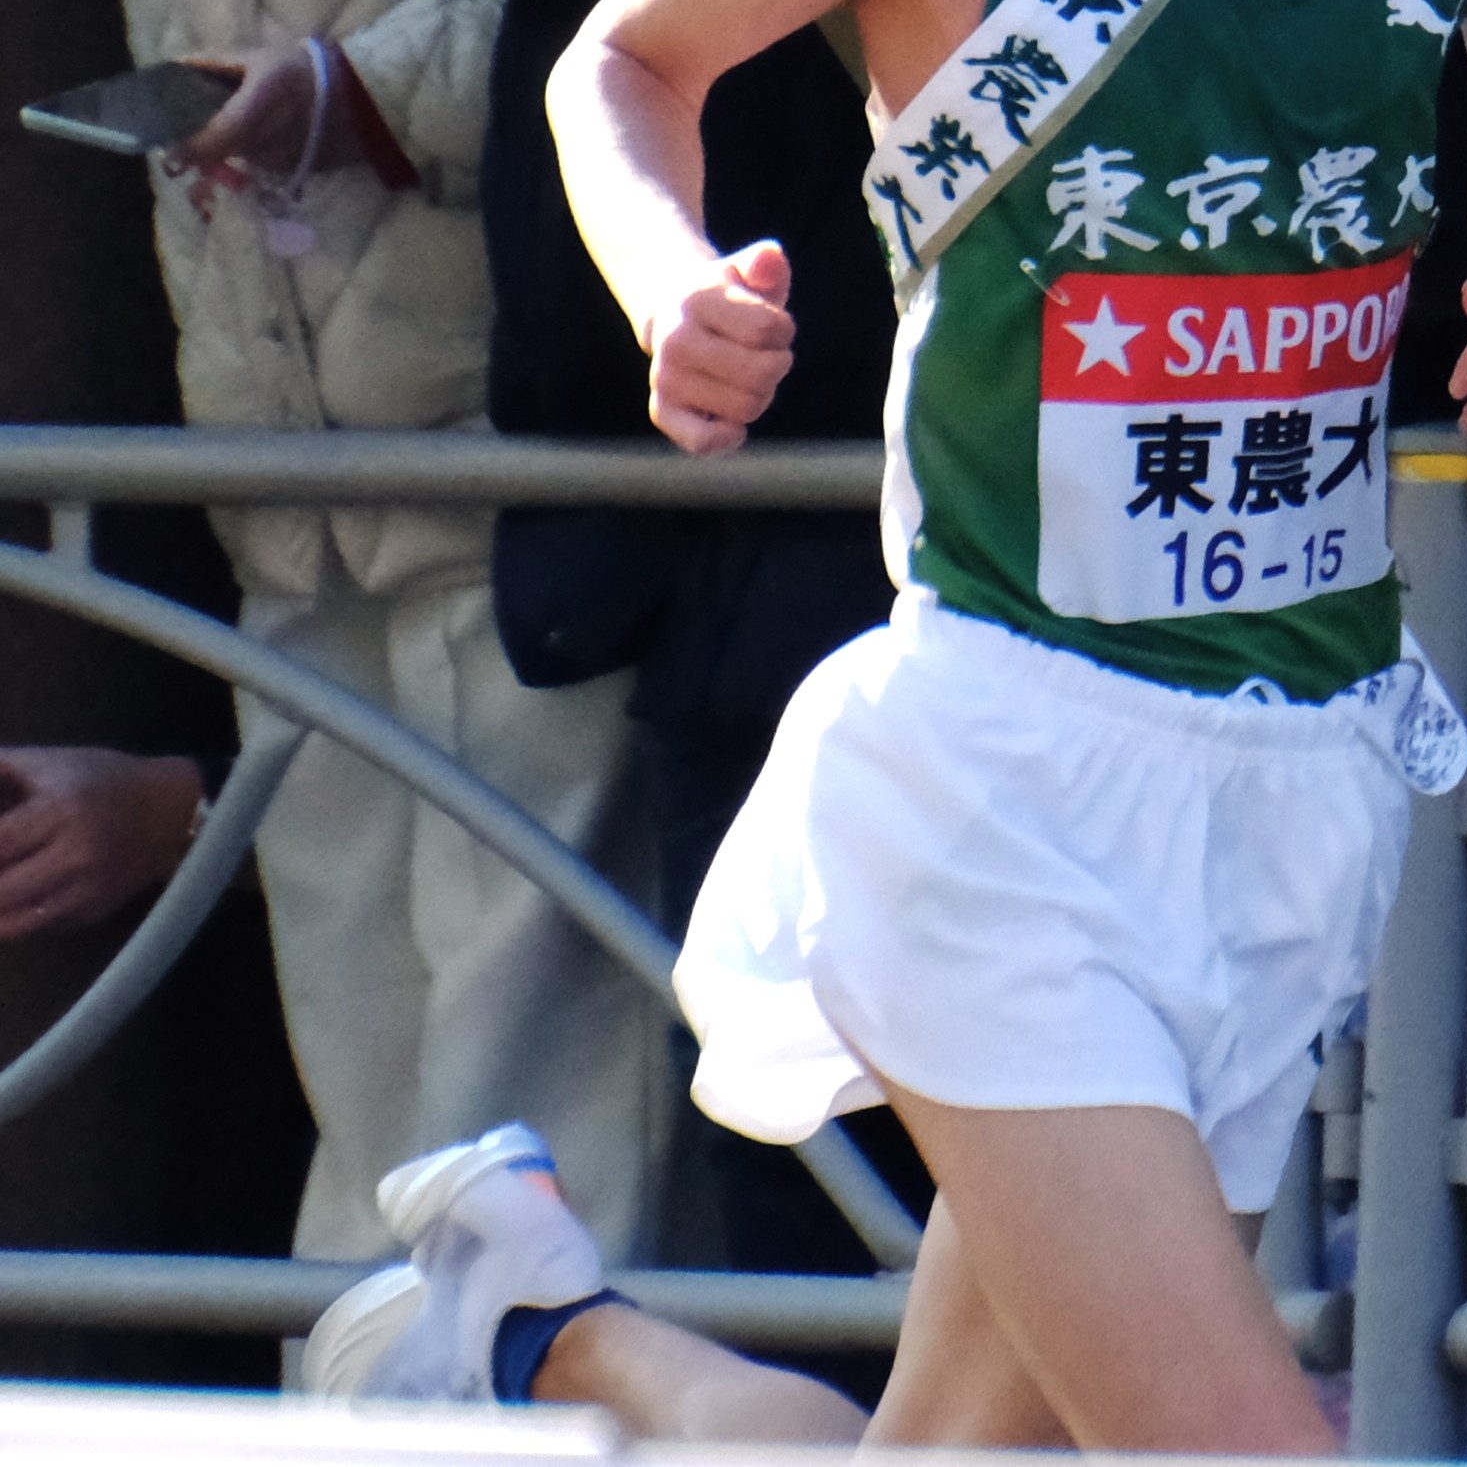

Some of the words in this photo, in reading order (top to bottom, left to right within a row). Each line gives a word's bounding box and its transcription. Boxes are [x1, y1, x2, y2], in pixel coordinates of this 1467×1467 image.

[1126, 396, 1381, 519] 東農大
[1164, 529, 1347, 607] 16-15
